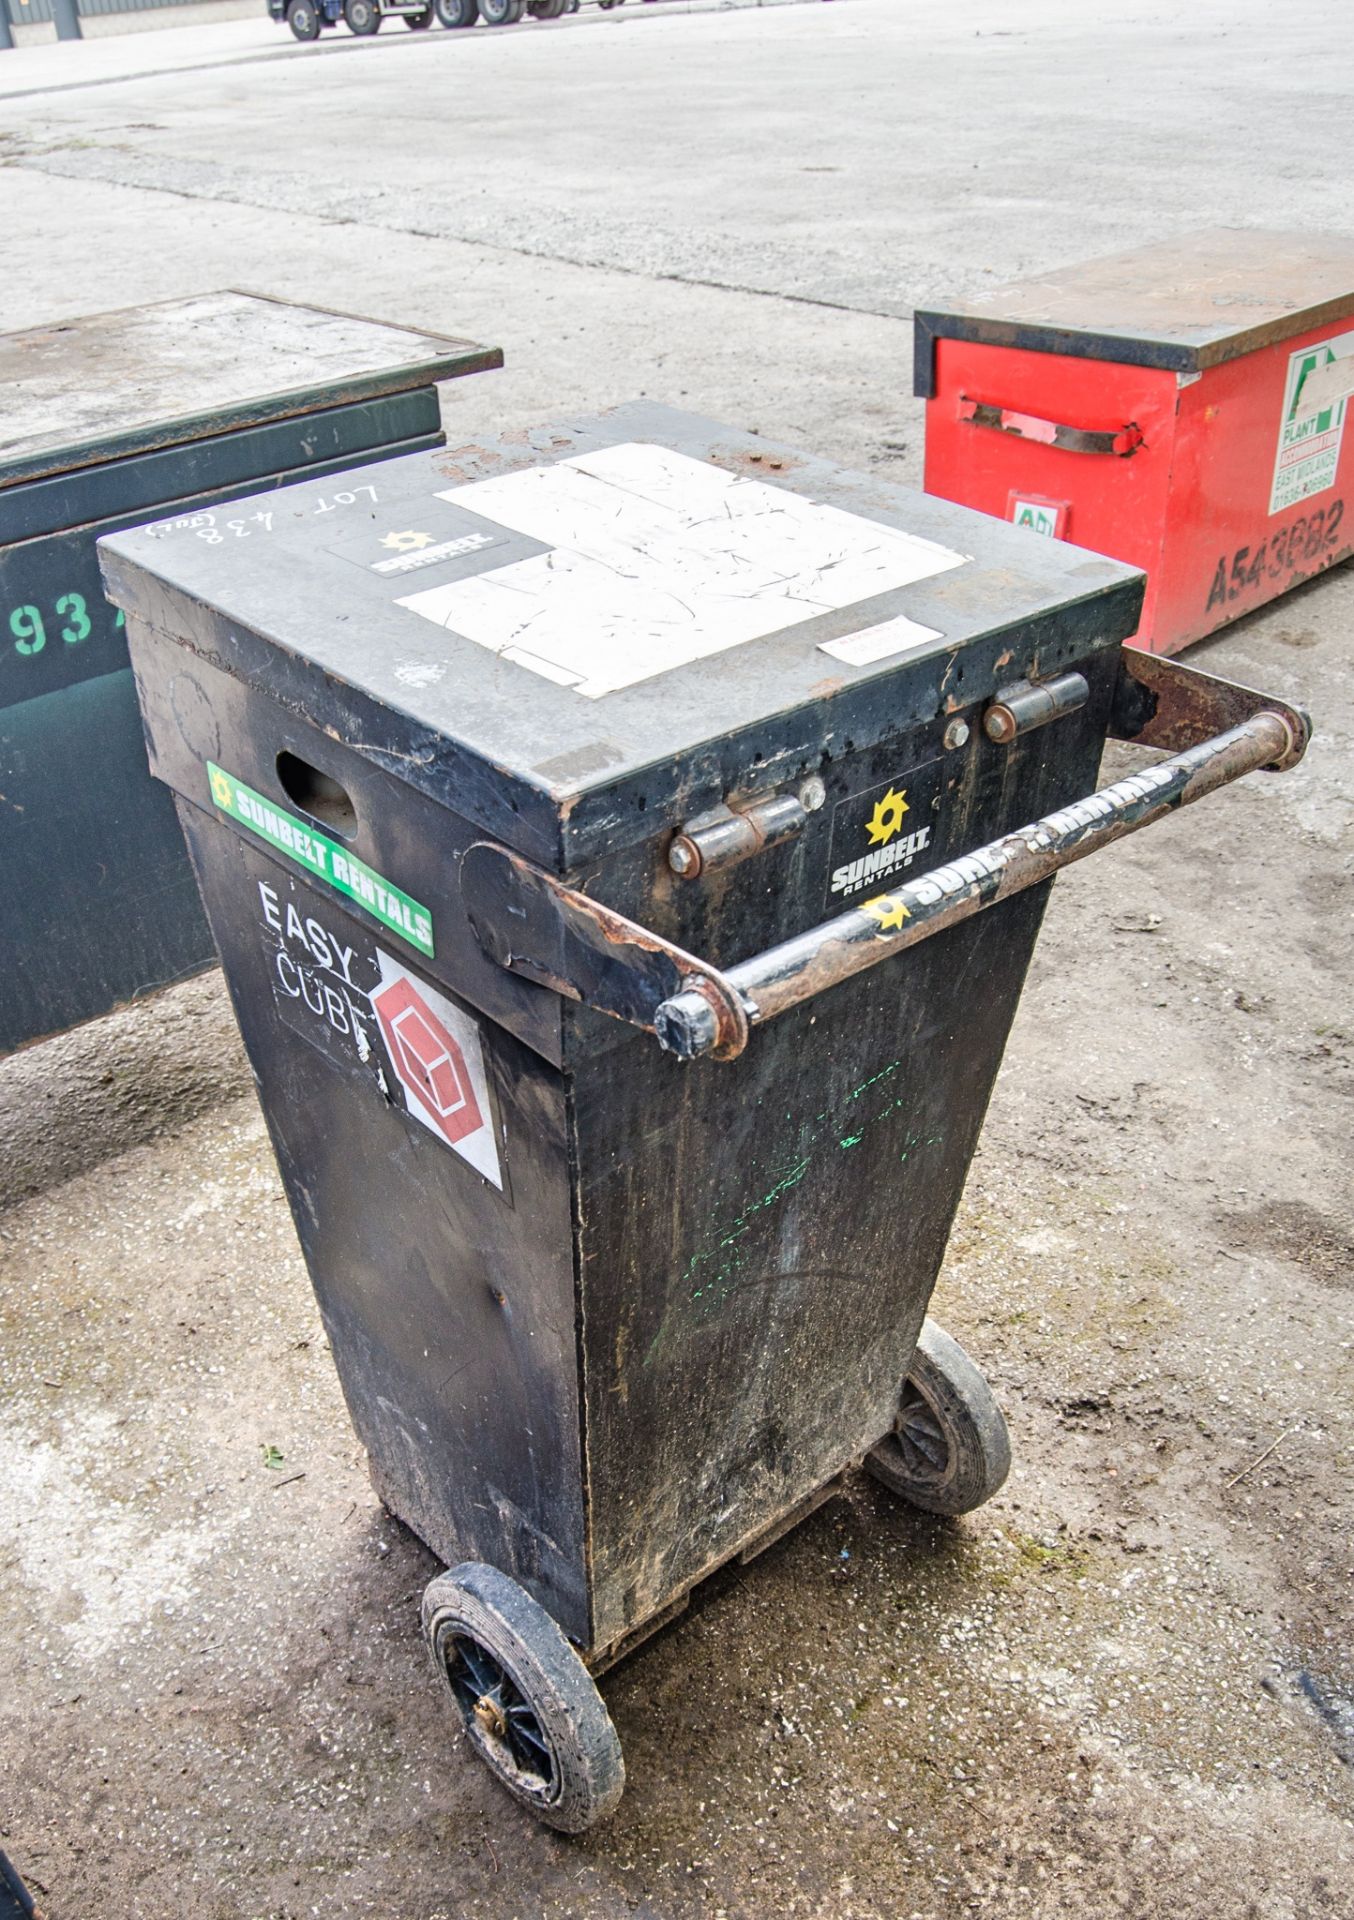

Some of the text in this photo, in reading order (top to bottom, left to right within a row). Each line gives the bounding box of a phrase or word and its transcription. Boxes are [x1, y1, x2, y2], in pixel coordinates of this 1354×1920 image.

[196, 485, 379, 545] LOT 438
[9, 592, 126, 656] 93
[235, 788, 434, 949] SUNBELT RENTALS
[831, 826, 930, 893] SUNBELT
[843, 855, 914, 897] RENTALS
[258, 880, 353, 982] EASY
